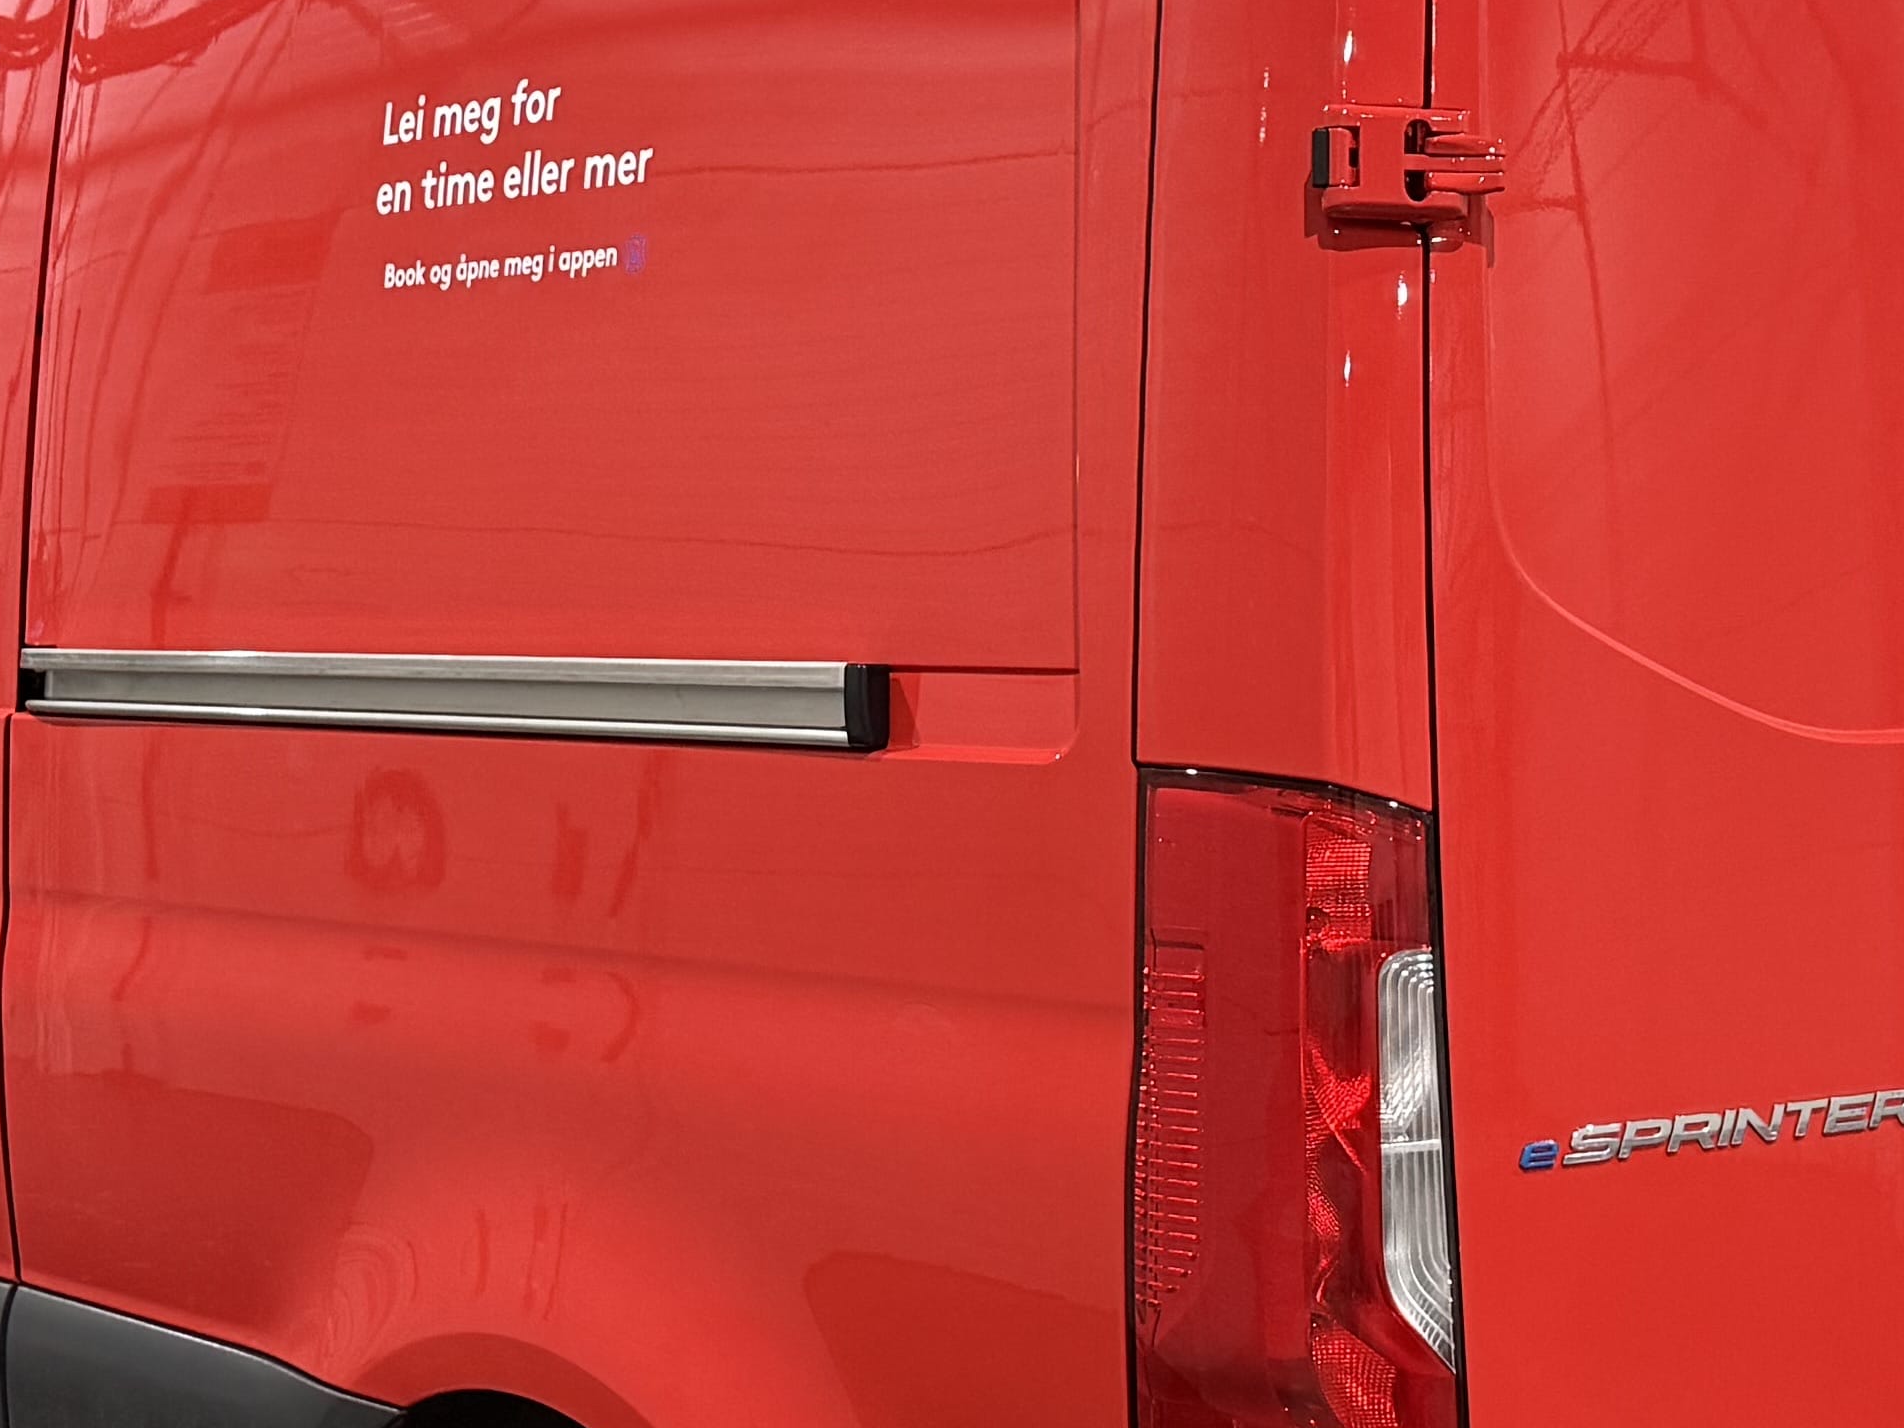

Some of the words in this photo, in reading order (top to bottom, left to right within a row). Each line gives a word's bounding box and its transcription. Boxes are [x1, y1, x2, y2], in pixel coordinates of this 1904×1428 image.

[382, 95, 427, 146] Lei
[432, 96, 501, 145] meg
[510, 78, 561, 126] for
[376, 178, 412, 216] en
[421, 161, 494, 210] time
[502, 149, 575, 199] eller
[583, 147, 653, 190] mer
[383, 259, 426, 290] Book
[429, 262, 452, 291] og
[455, 253, 500, 289] åpne
[504, 254, 544, 283] meg
[547, 244, 556, 272] i
[558, 246, 618, 279] appen
